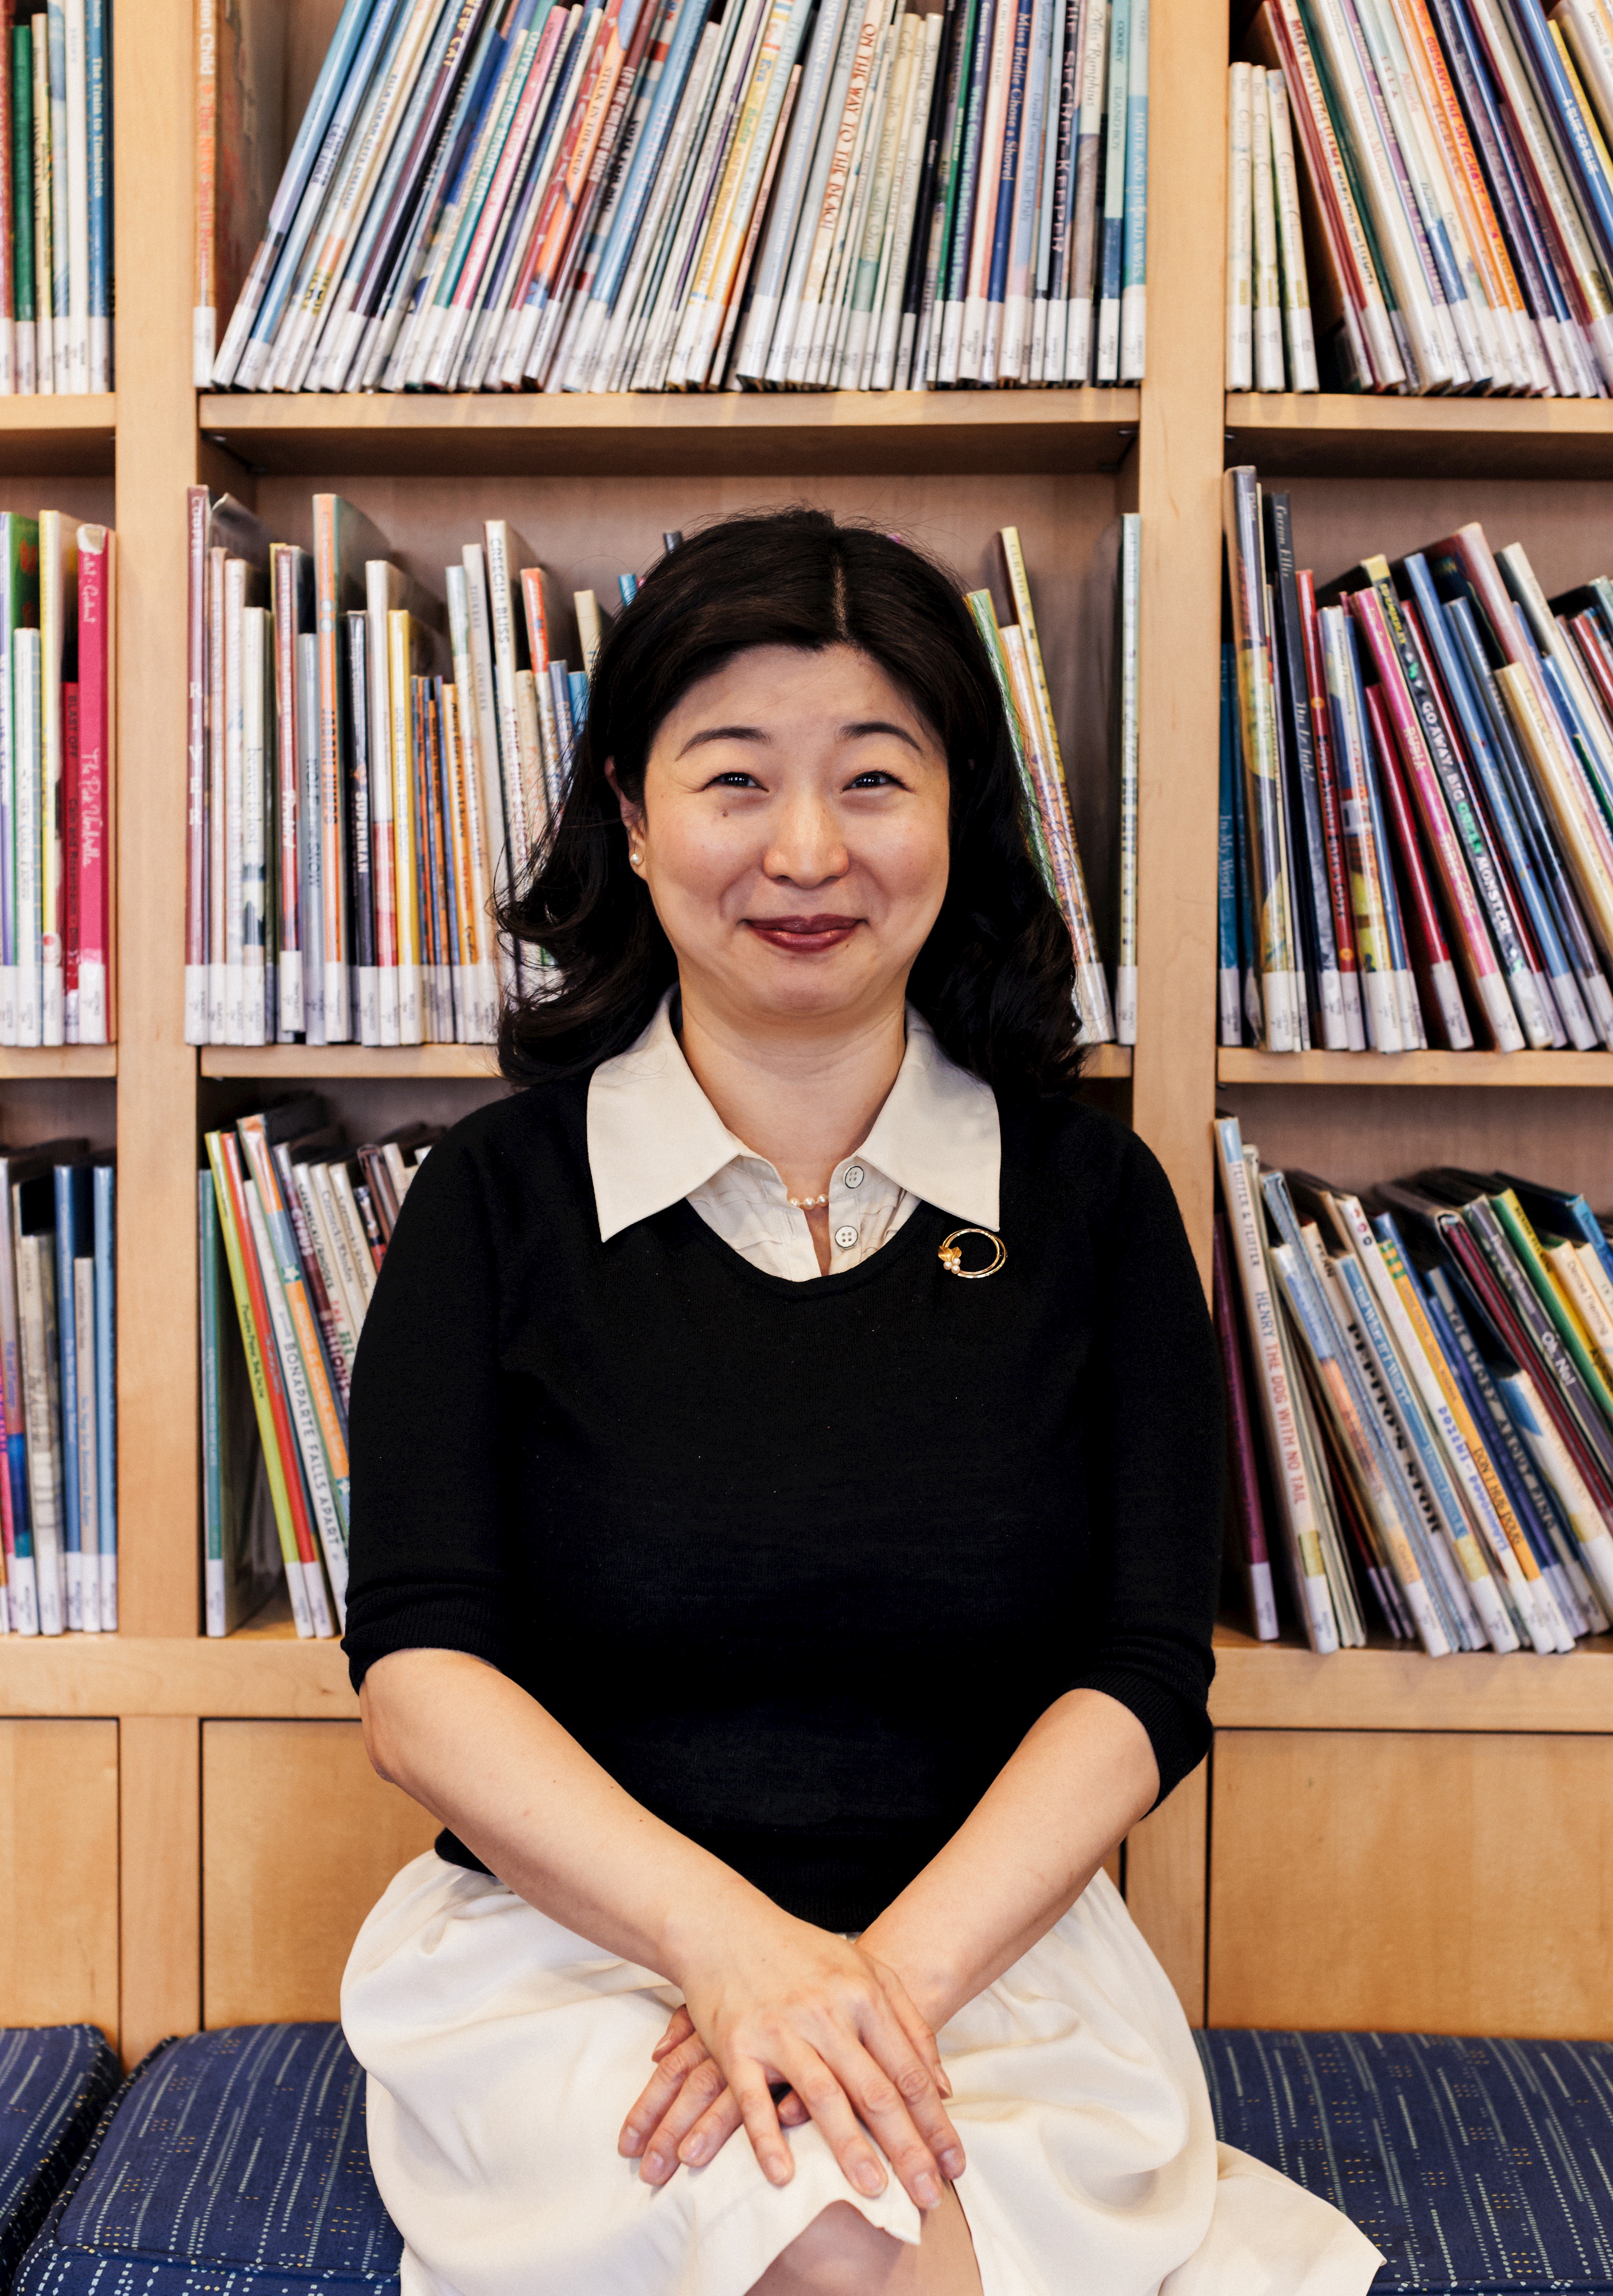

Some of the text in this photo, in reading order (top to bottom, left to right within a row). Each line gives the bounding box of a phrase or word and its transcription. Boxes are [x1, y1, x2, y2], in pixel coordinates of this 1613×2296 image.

[1014, 13, 1030, 43] Miss
[1114, 20, 1124, 64] COONEY
[92, 56, 102, 79] The
[200, 34, 215, 74] Child
[441, 34, 468, 70] CAT
[619, 65, 637, 85] LET
[1011, 46, 1027, 86] Bridie
[92, 82, 102, 114] Train
[200, 104, 214, 131] The
[471, 28, 541, 205] OLIVE and the MAGIC HAT
[612, 85, 631, 105] THE
[738, 57, 773, 145] Eva Sadie
[802, 101, 816, 125] FROM
[968, 85, 981, 121] When
[1007, 87, 1023, 128] Chose
[1423, 35, 1486, 197] GUSTAVO THE SHY GHOST
[92, 118, 102, 131] to
[569, 65, 613, 175] STUCK IN THE MUD
[598, 103, 624, 150] CHILDREN
[620, 118, 641, 154] VOTE
[798, 127, 810, 144] THE
[817, 22, 877, 230] ON THE WAY TO THE BEACH
[1562, 97, 1599, 175] A BLUE SO BLUE
[199, 136, 213, 174] NEW
[611, 156, 629, 184] FOR
[1002, 140, 1019, 181] Shovel
[199, 180, 213, 223] Small
[191, 496, 202, 557] COOPER
[489, 538, 510, 644] CREECH BLISS
[1009, 544, 1028, 594] CURATO
[68, 695, 77, 759] BLAST OFF
[504, 707, 516, 719] A
[188, 681, 203, 826] RIVER
[322, 708, 337, 824] JABARI JUMPS
[1402, 725, 1428, 772] RUBIA
[246, 747, 261, 844] beaver is lost
[1420, 699, 1514, 936] GO AWAY, BIG GREEN MONSTER!
[355, 791, 369, 873] SUPERMAN
[68, 798, 78, 915] Cain and Rosenbaum
[1219, 815, 1233, 899] In My World
[1565, 1259, 1610, 1337] Denise Fleming
[1538, 1329, 1579, 1387] Oh, No!
[1254, 1290, 1306, 1505] HENRY THE DOG WITH NO TAIL
[283, 1341, 340, 1546] BONAPARTE FALLS APART
[1489, 1483, 1509, 1511] HUG
